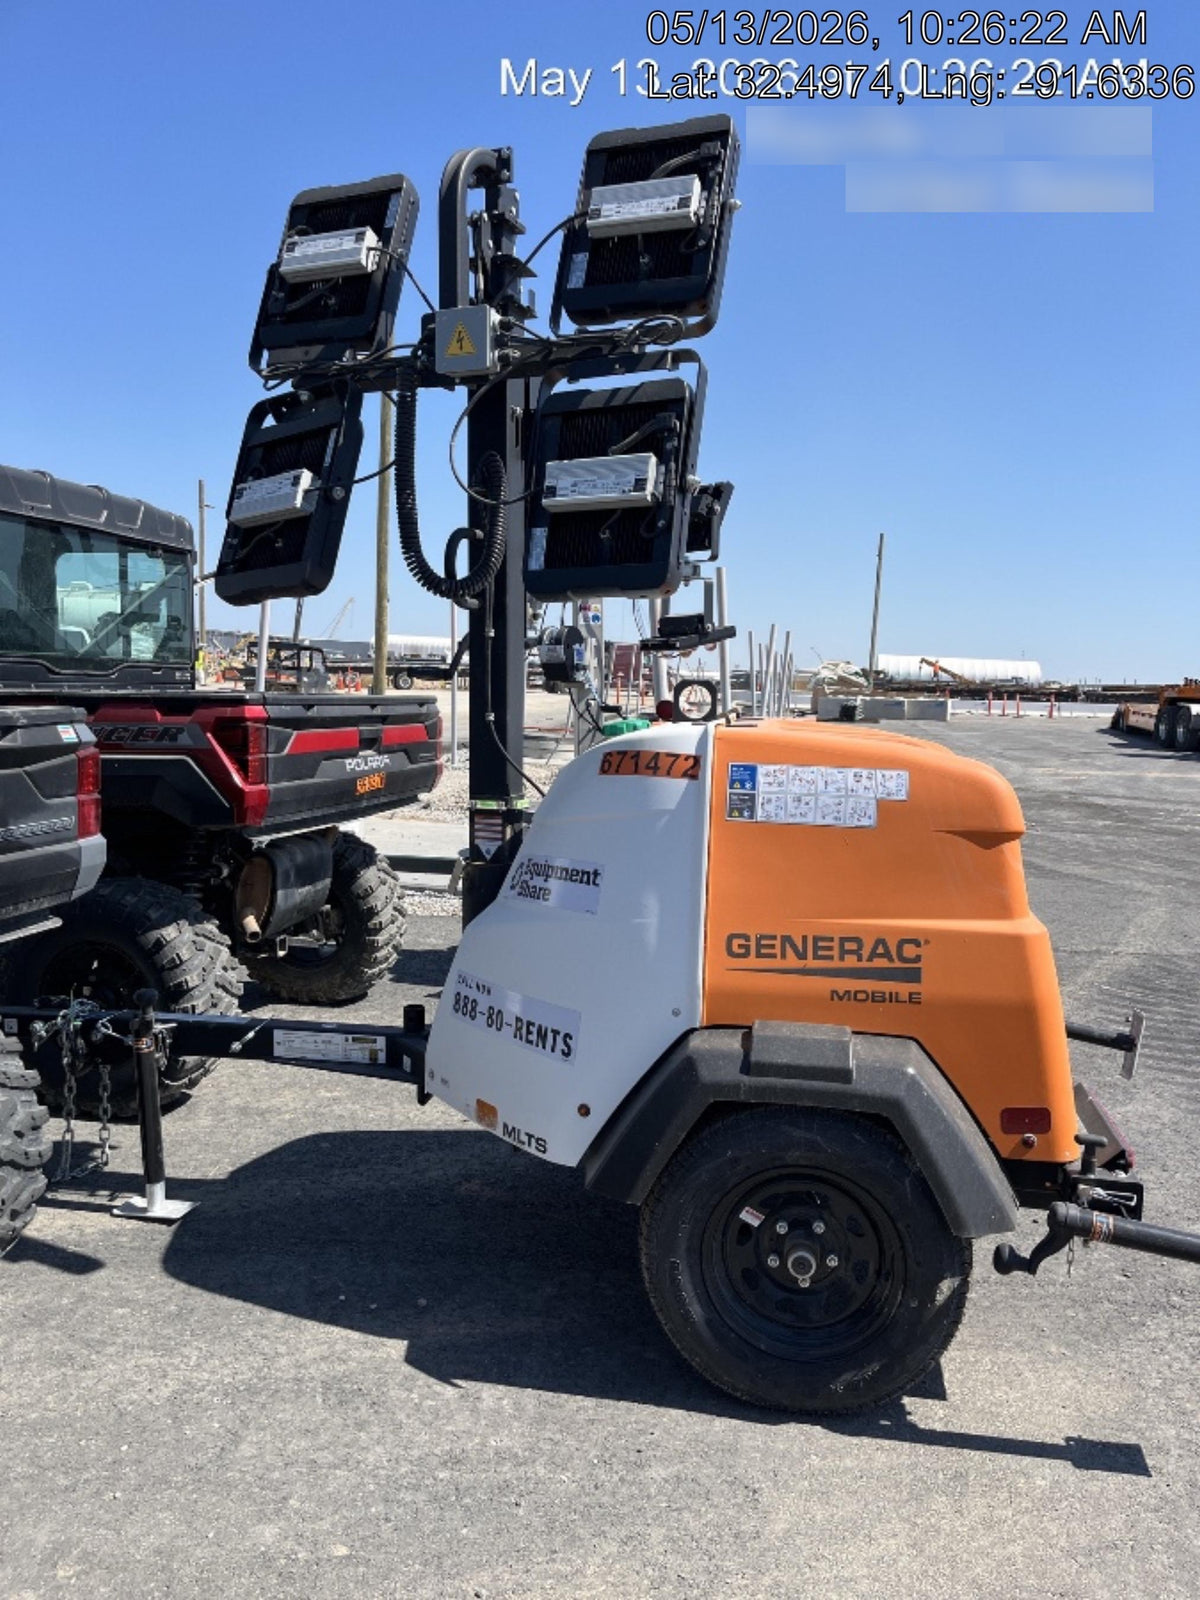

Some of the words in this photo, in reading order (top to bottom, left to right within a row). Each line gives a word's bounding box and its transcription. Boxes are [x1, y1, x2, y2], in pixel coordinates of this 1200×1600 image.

[600, 750, 702, 780] 671472
[524, 858, 602, 887] Equipment
[725, 933, 922, 964] GENERAC
[830, 989, 922, 1004] MOBILE
[453, 991, 573, 1058] 888-80-RENTS
[502, 1121, 548, 1155] MLTS
